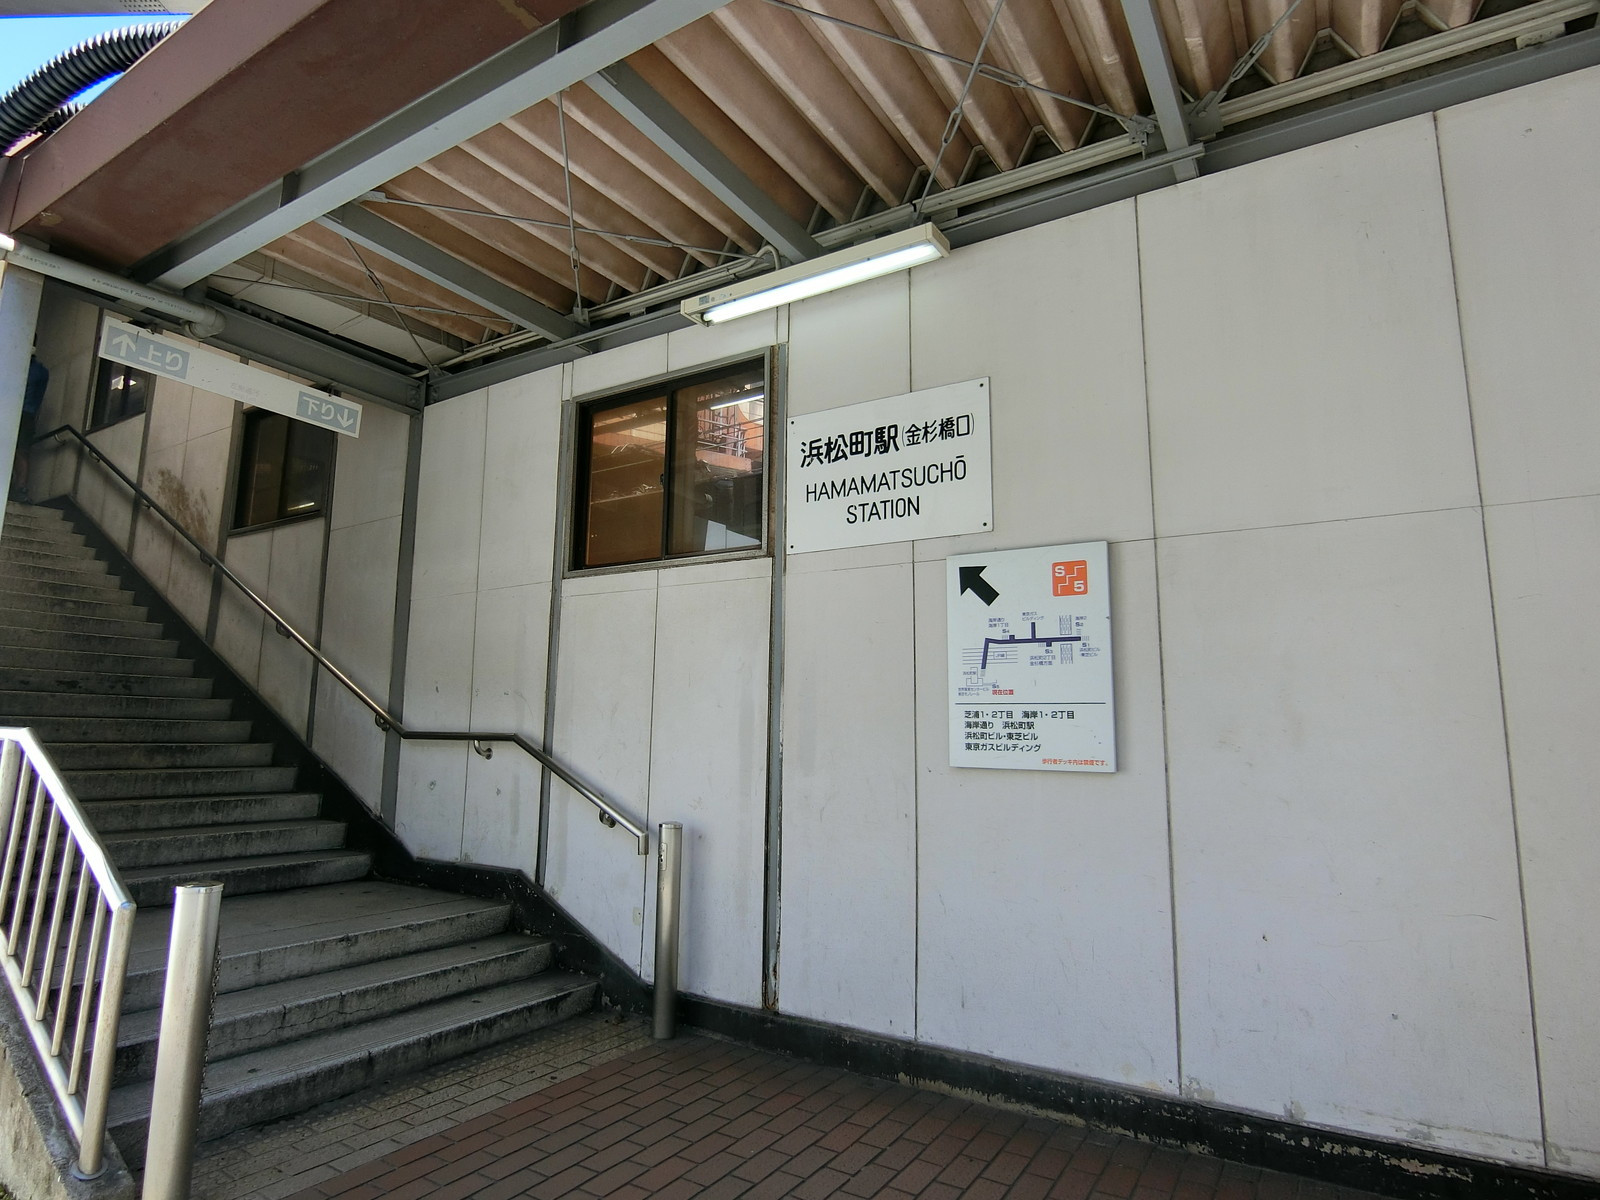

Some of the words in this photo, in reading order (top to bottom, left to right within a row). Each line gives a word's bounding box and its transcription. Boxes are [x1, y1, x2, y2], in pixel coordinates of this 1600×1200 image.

[139, 344, 183, 371] 上り
[303, 396, 335, 420] 下り
[846, 495, 920, 524] STATION
[1074, 581, 1085, 592] 5
[964, 721, 994, 730] 海岸通り
[1002, 721, 1035, 730] 浜松町駅
[964, 742, 1042, 753] 東京ガスビルディング
